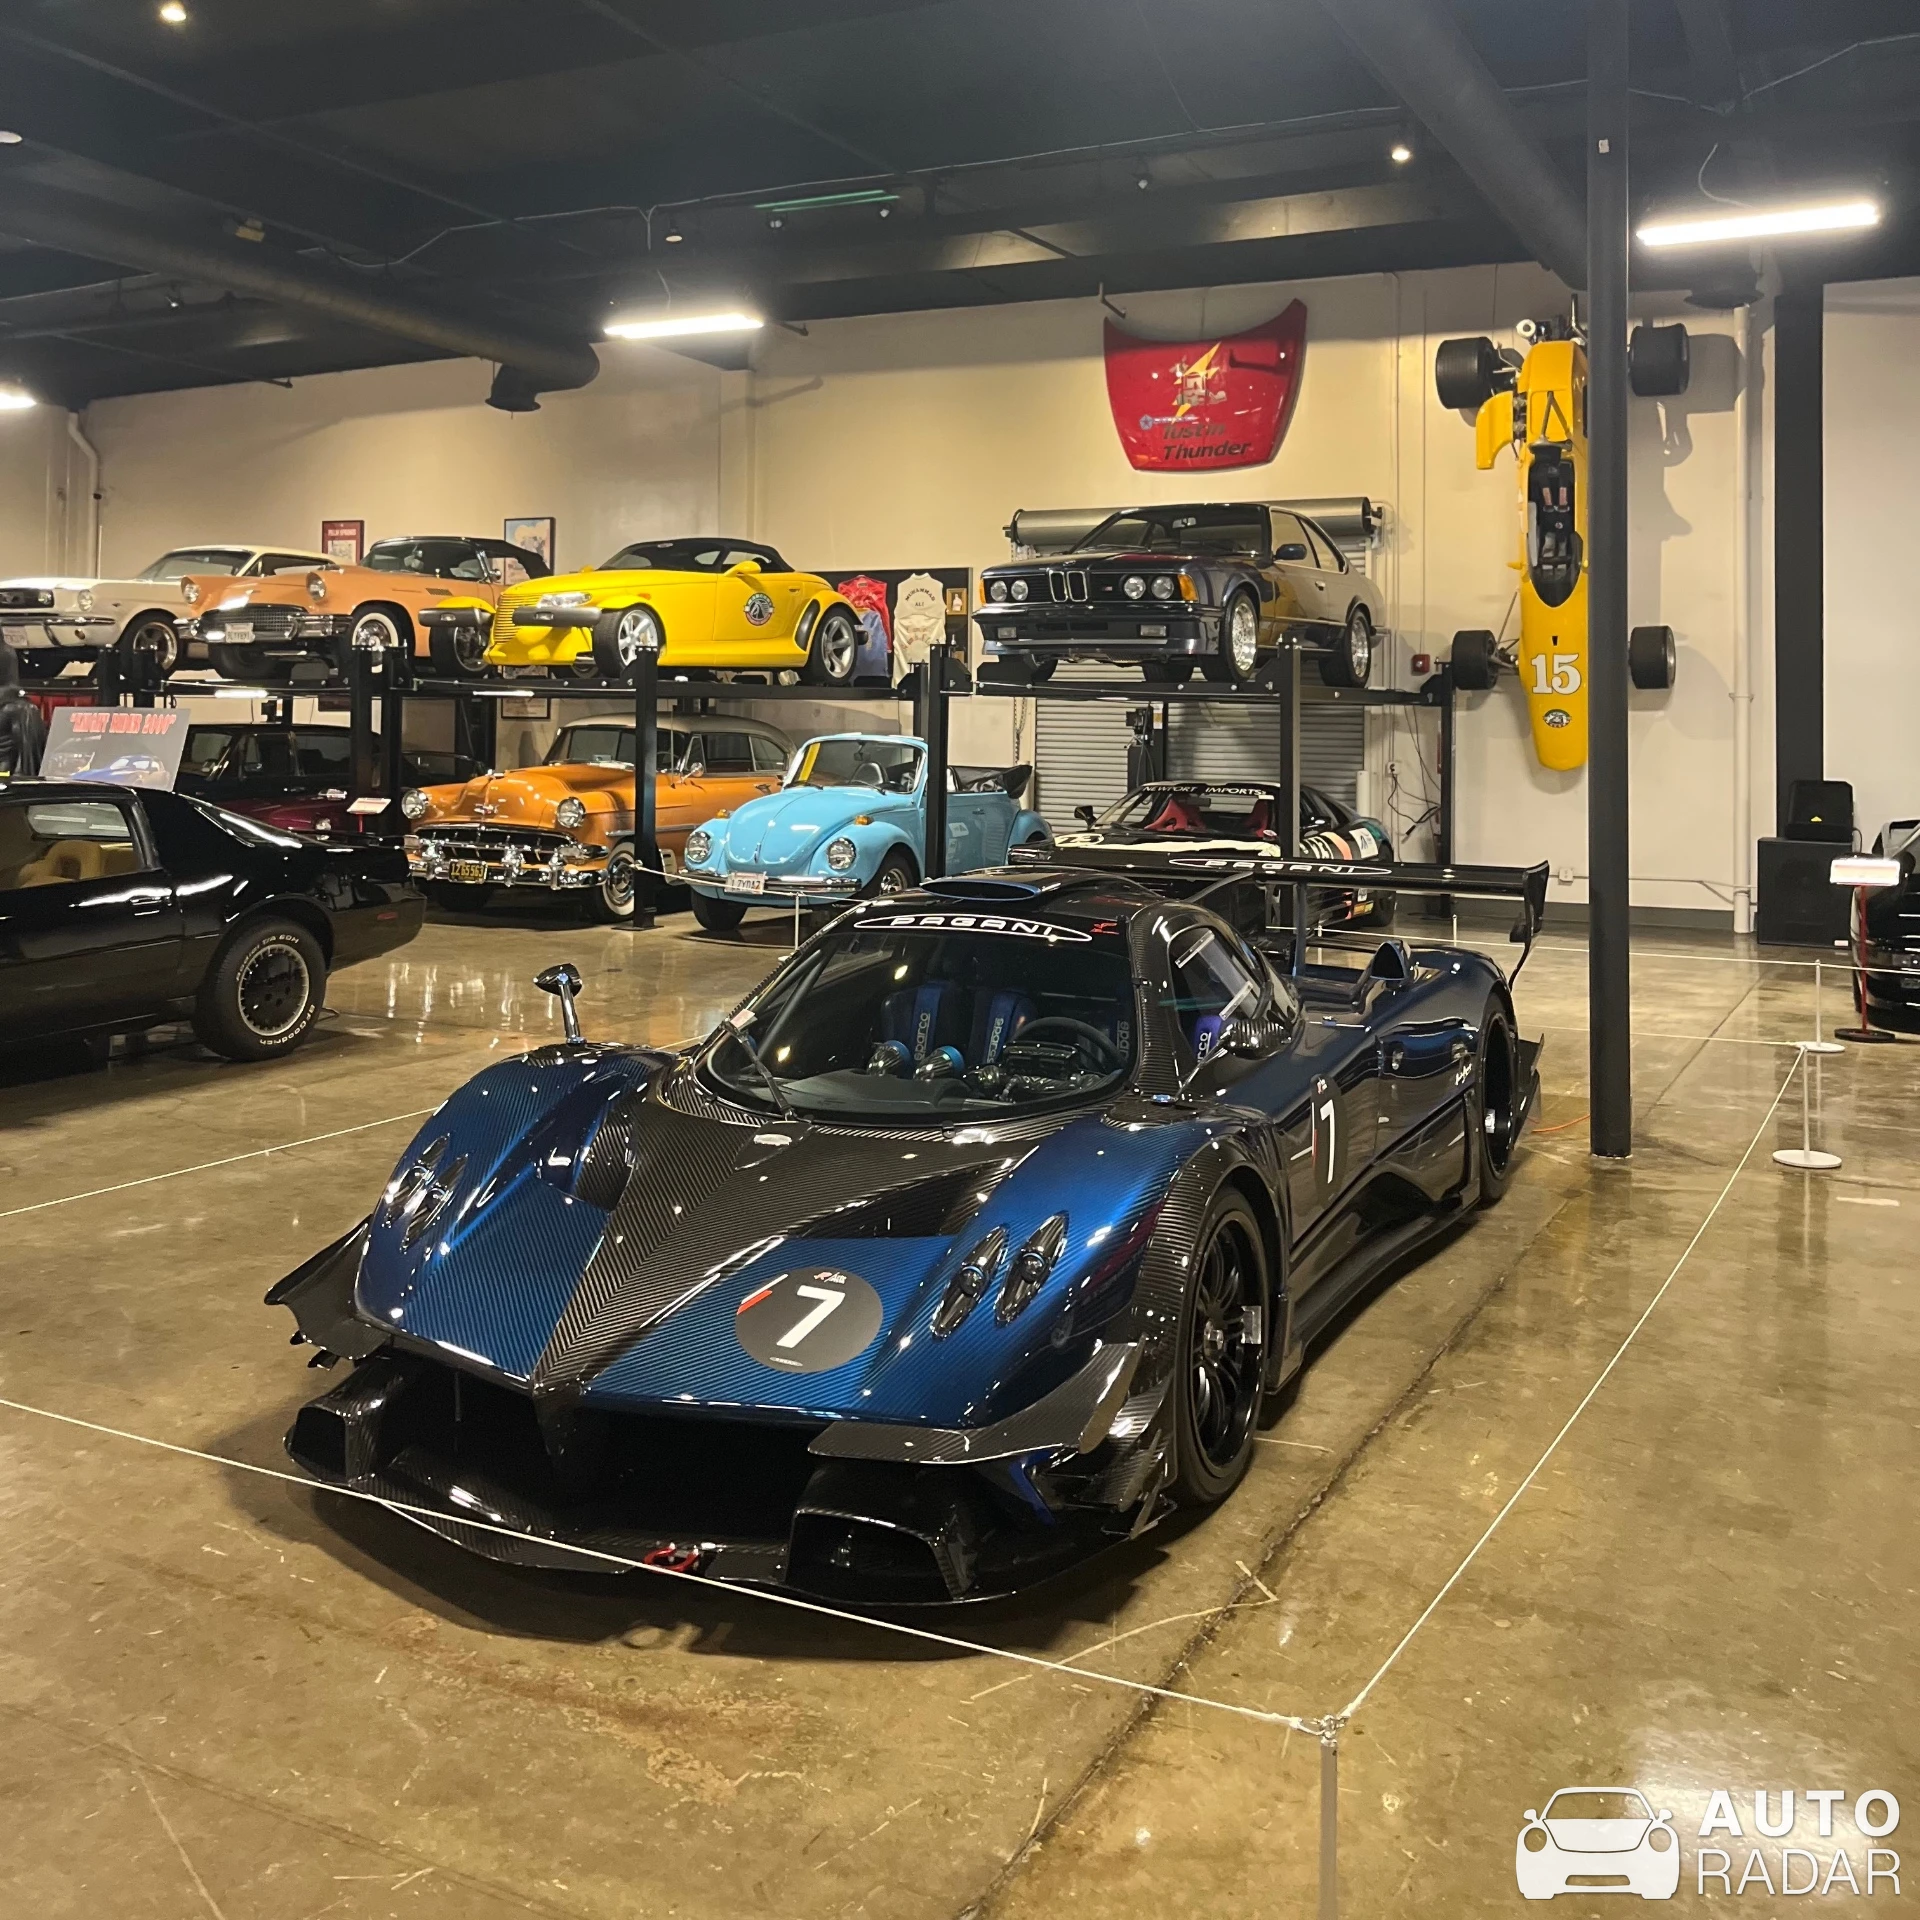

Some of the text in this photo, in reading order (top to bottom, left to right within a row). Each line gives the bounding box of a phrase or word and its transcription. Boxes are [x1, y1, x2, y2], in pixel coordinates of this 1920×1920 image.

[1163, 422, 1226, 440] Tustin
[1164, 440, 1252, 461] Thunder
[904, 587, 936, 602] MUHAMMAD
[1531, 653, 1582, 695] 15
[1142, 785, 1197, 793] NEWPORT
[1204, 859, 1355, 873] PAGANI
[890, 916, 1053, 936] PAGANI
[278, 934, 300, 944] 60H
[1319, 1098, 1336, 1184] 7
[775, 1284, 846, 1349] 7
